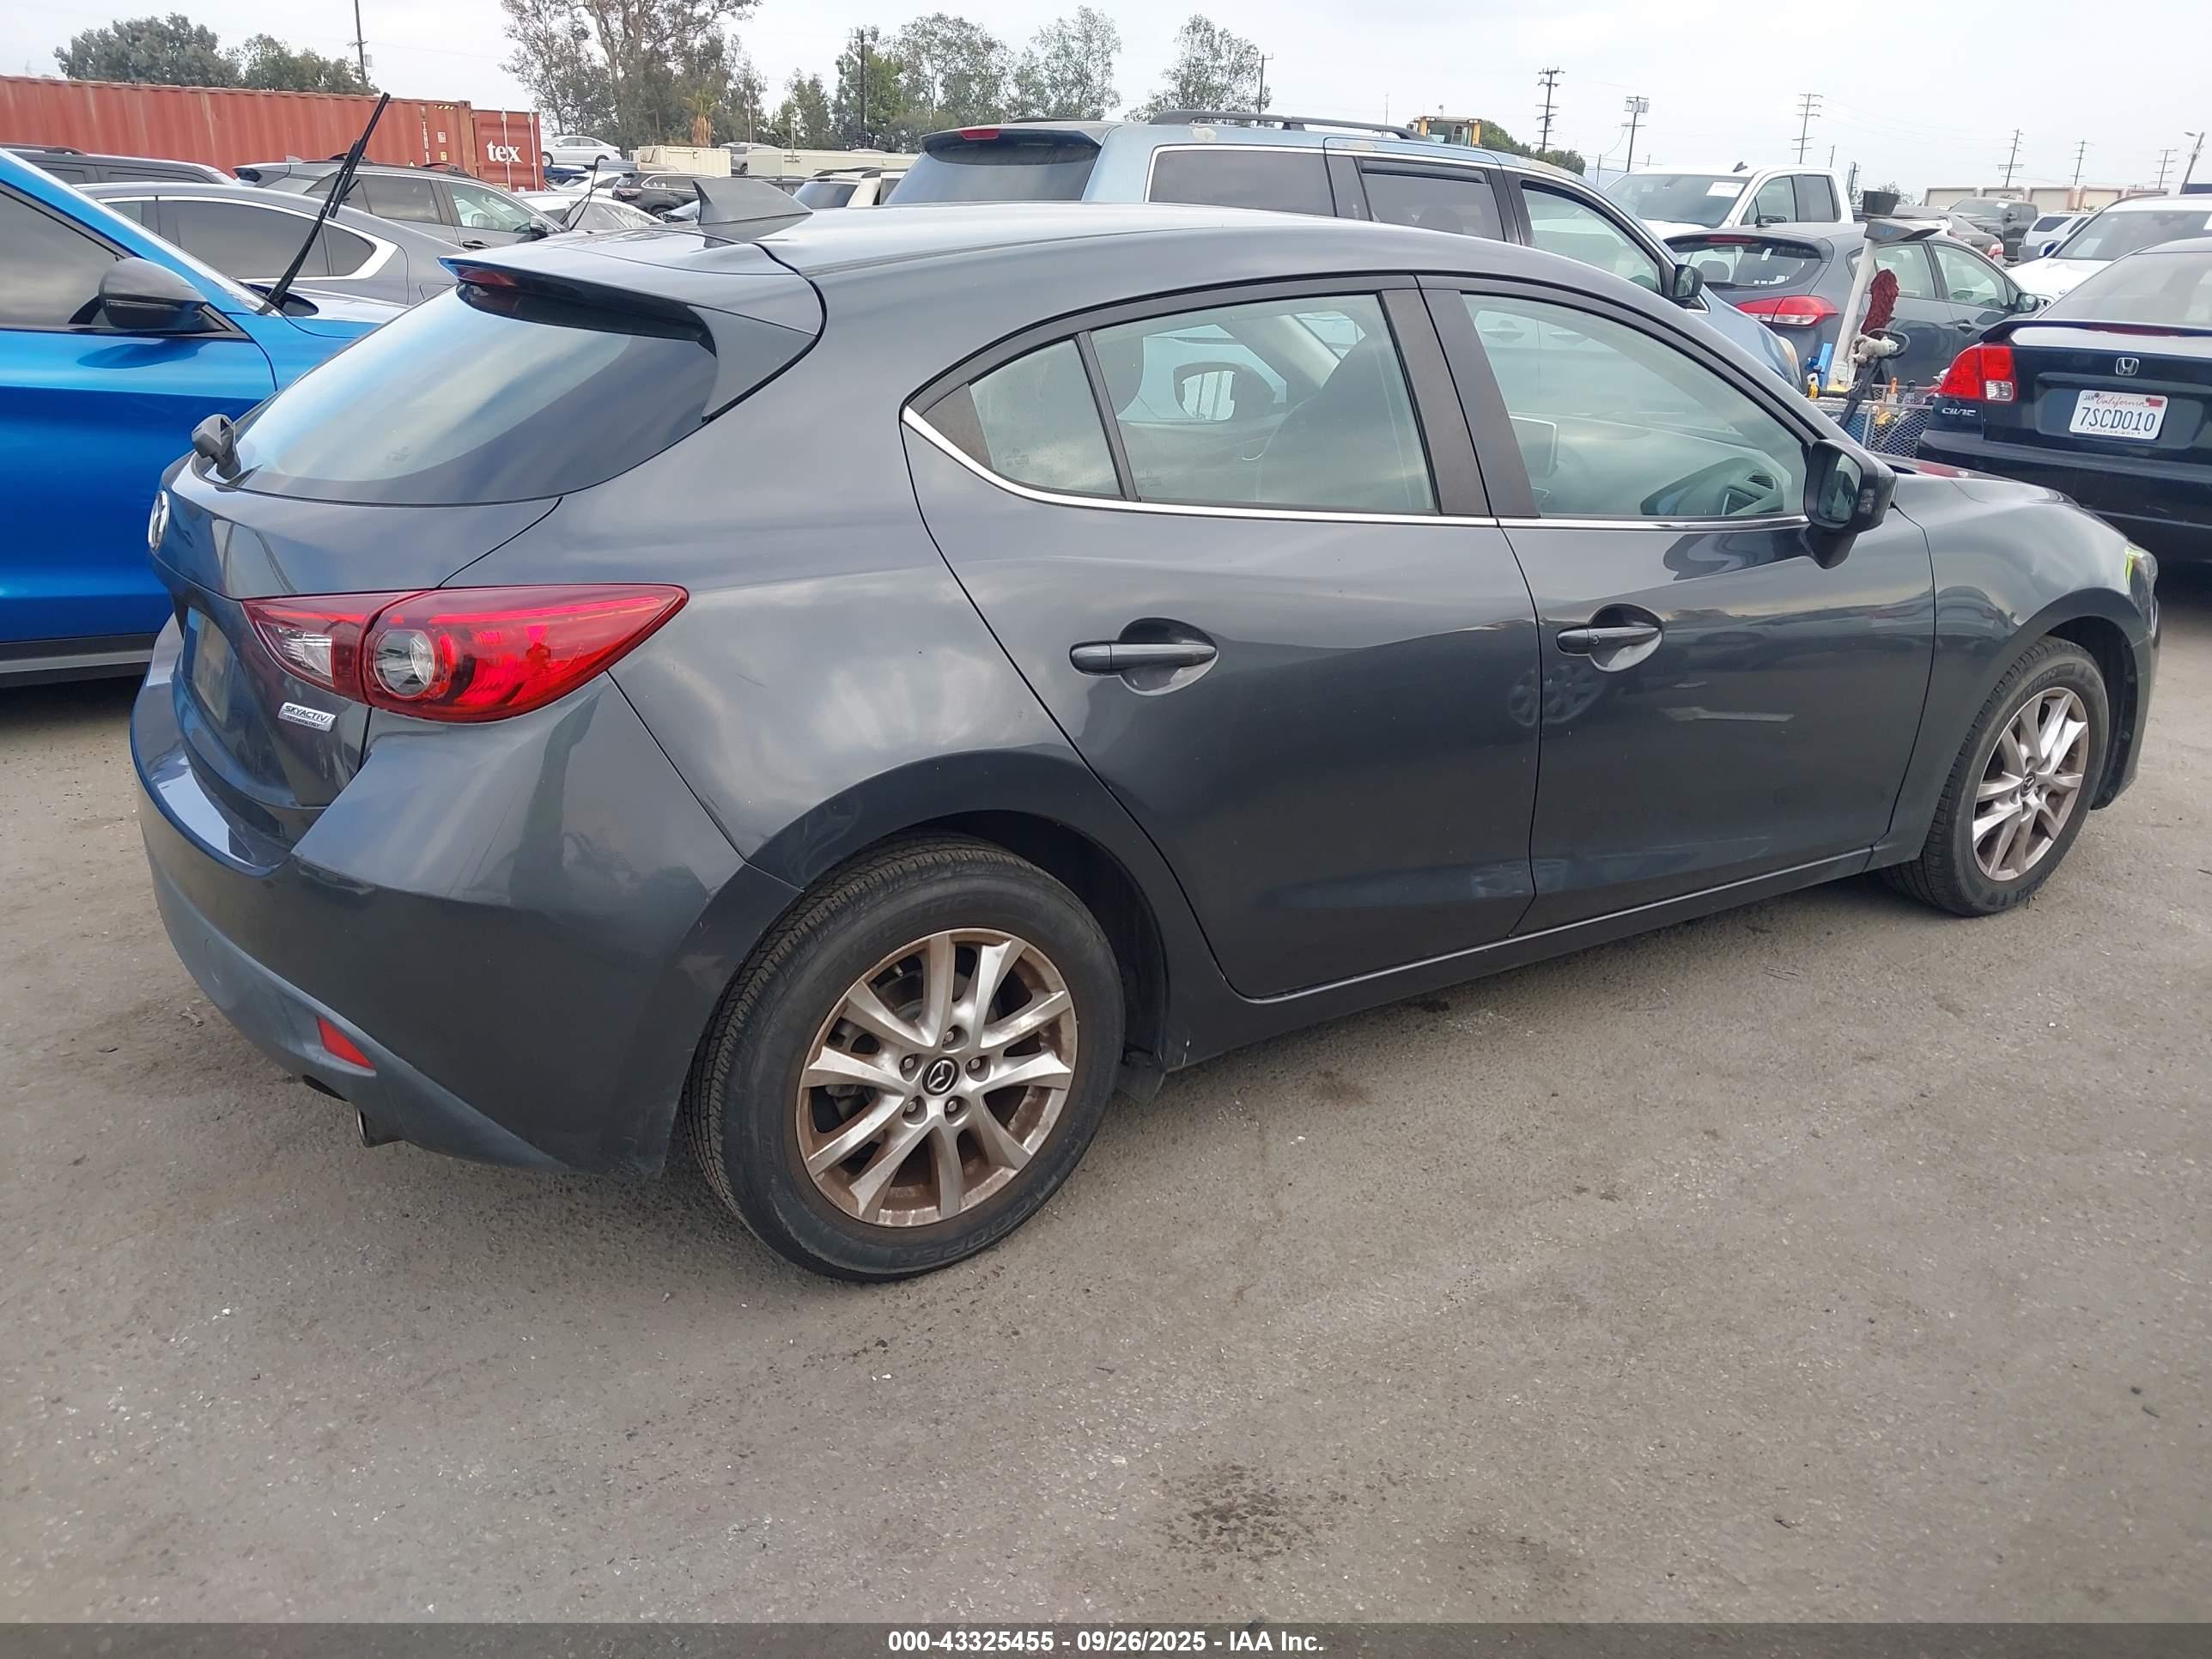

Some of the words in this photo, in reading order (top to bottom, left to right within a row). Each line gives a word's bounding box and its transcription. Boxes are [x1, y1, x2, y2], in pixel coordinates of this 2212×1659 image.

[486, 138, 523, 164] tex
[2095, 395, 2145, 408] California
[2080, 406, 2156, 432] 7SCD010
[283, 705, 328, 722] SKYACTIV
